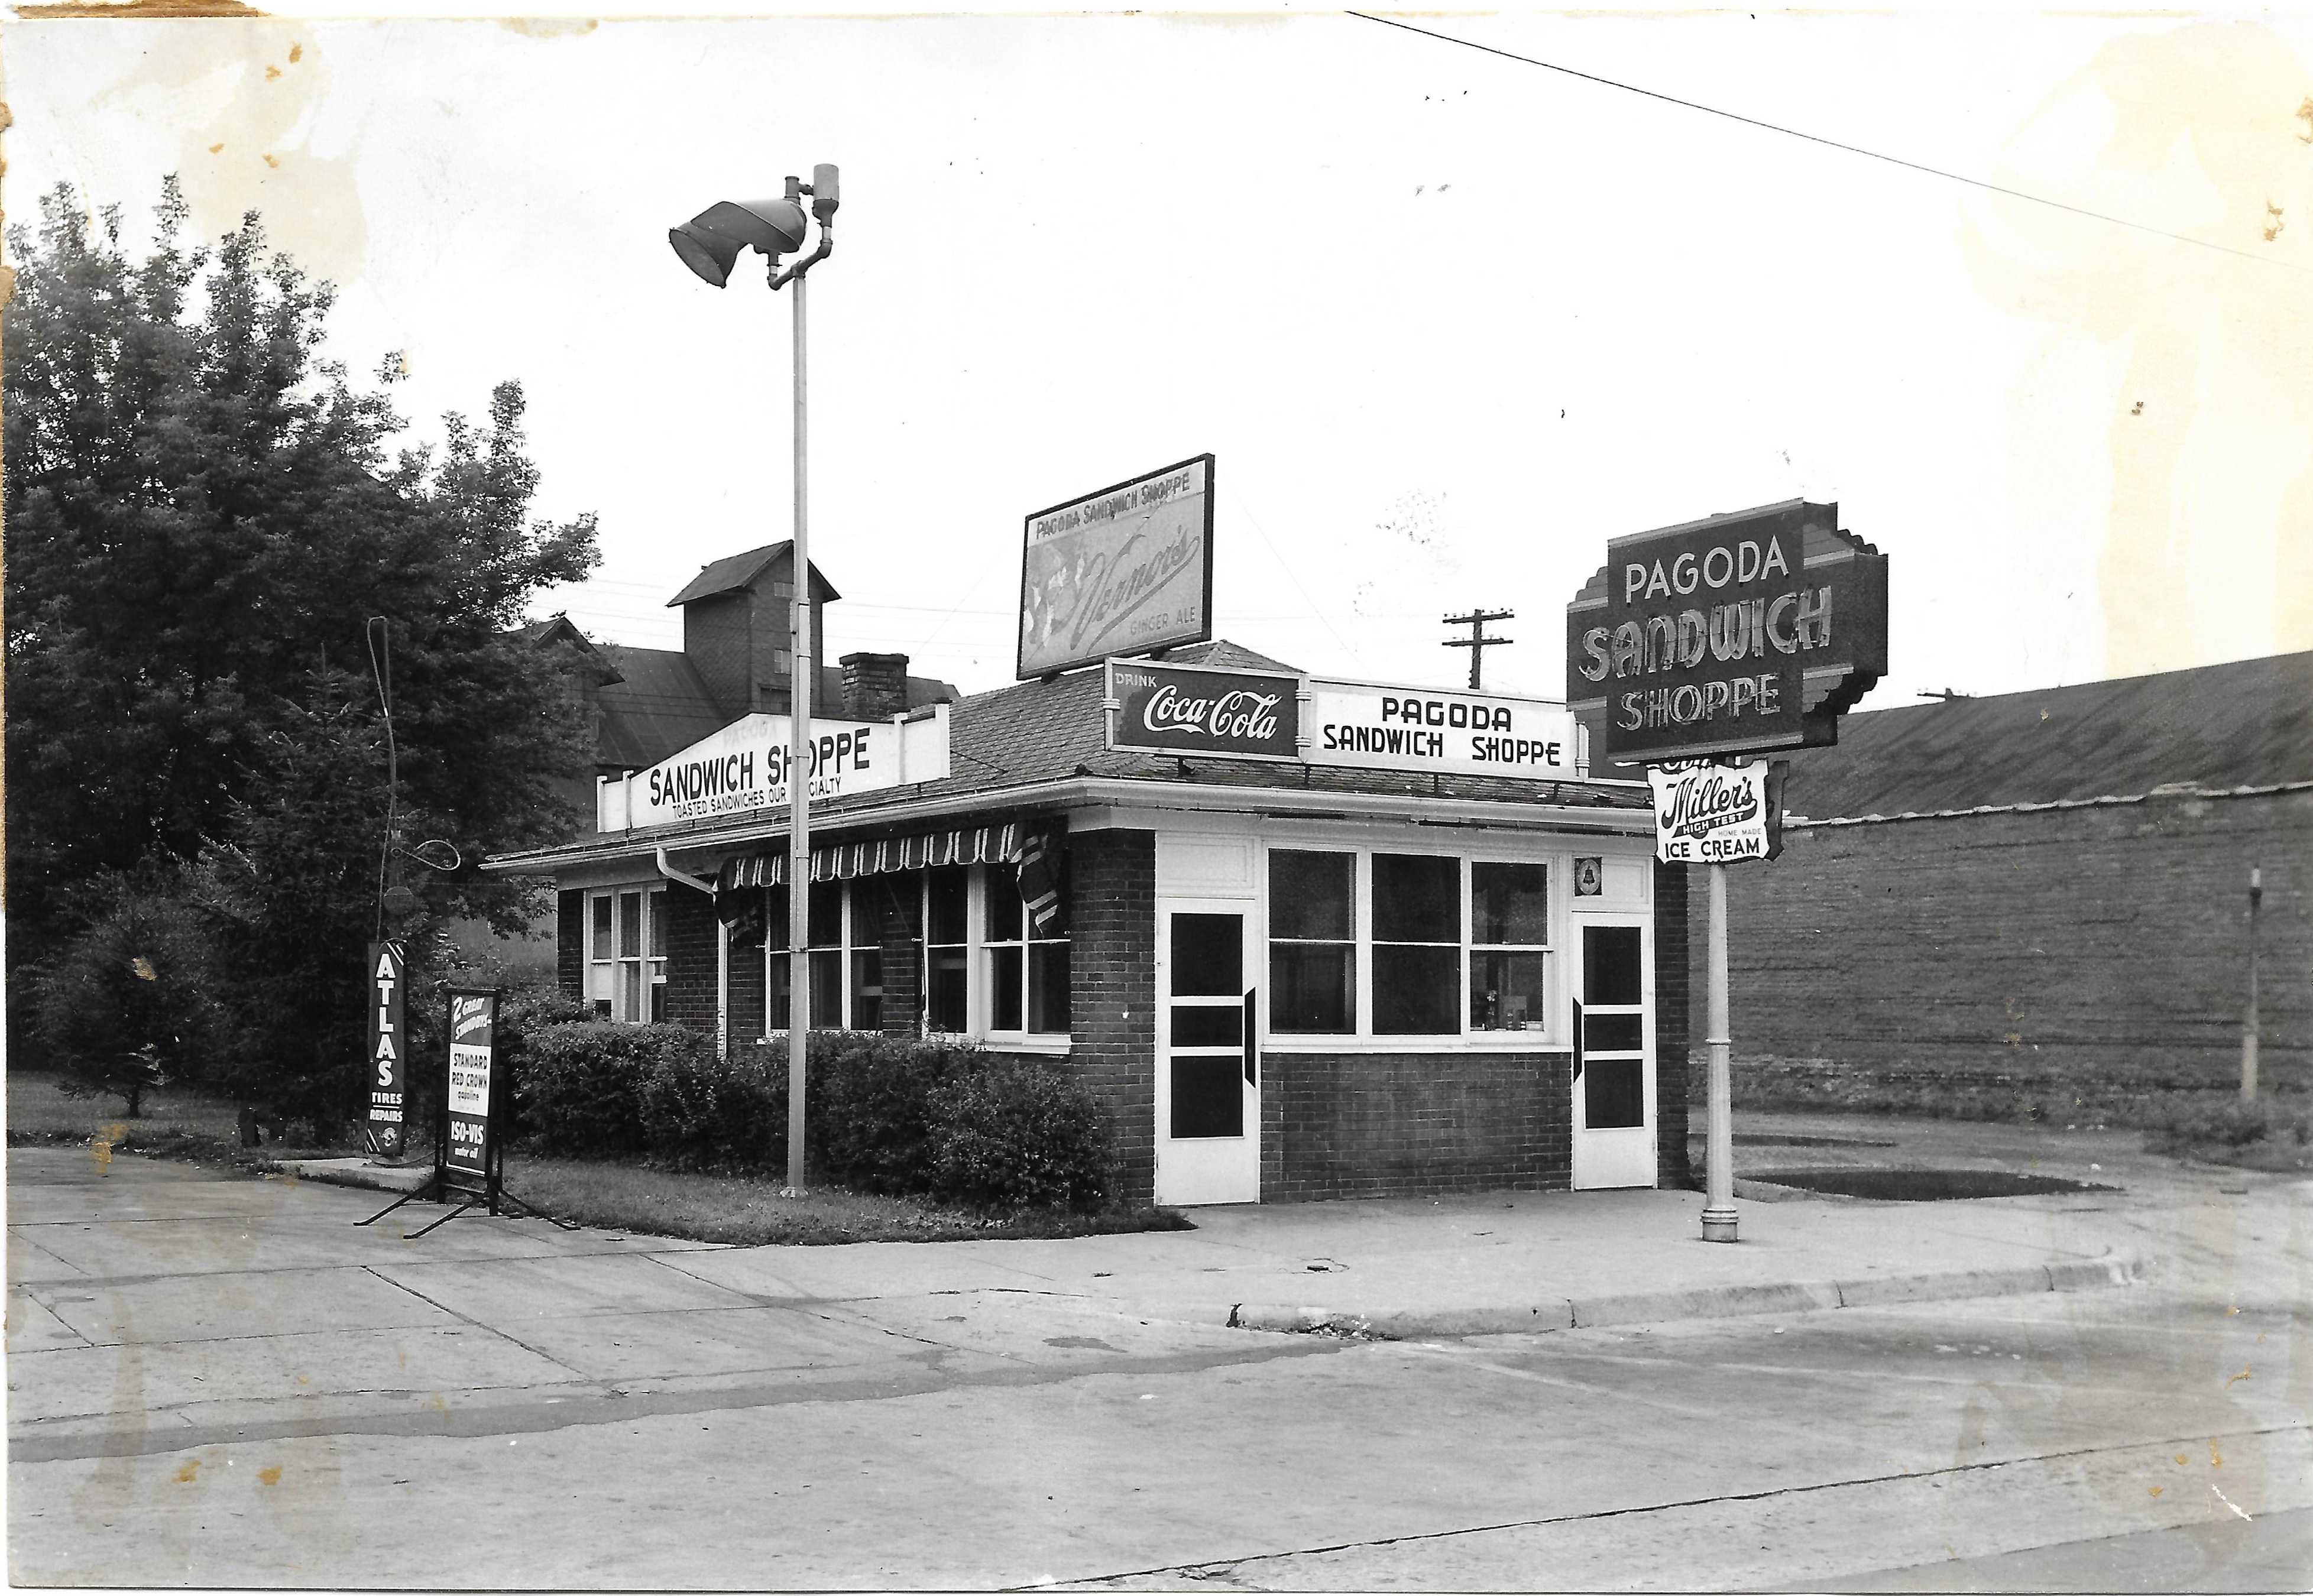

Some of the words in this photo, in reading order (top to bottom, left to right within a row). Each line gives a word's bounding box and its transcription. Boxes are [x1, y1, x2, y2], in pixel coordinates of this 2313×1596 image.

[1036, 510, 1081, 540] PAGODA
[1084, 490, 1138, 525] SANDWICH
[1141, 472, 1190, 505] SHOPPE
[1625, 534, 1790, 606] PAGODA
[1130, 612, 1169, 635] GINGER
[1176, 606, 1196, 625] ALE
[1578, 585, 1832, 682] SANDWICH
[1115, 673, 1158, 687] DRINK
[1143, 685, 1282, 740] Coca-Cola
[1382, 697, 1512, 732] PAGODA
[1616, 673, 1781, 731] SHOPPE
[1323, 724, 1444, 758] SANDWICH
[1472, 737, 1561, 767] SHOPPE
[650, 751, 753, 806] SANDWICH
[672, 800, 708, 819] TOASTED
[711, 789, 765, 813] SANDWICHES
[768, 787, 786, 803] OUR
[1661, 776, 1758, 829] Miller's
[1683, 820, 1709, 835] HIGH
[1713, 812, 1744, 826] TEST
[1665, 842, 1690, 859] ICE
[1700, 838, 1760, 859] CREAM
[375, 953, 397, 1087] ATLAS
[453, 996, 463, 1023] 2
[453, 1053, 488, 1070] STANDARD
[452, 1072, 465, 1086] RED
[467, 1073, 488, 1089] CROWN
[371, 1092, 403, 1105] TIRES
[370, 1109, 403, 1123] REPAIRS
[451, 1121, 484, 1145] ISO-VIS
